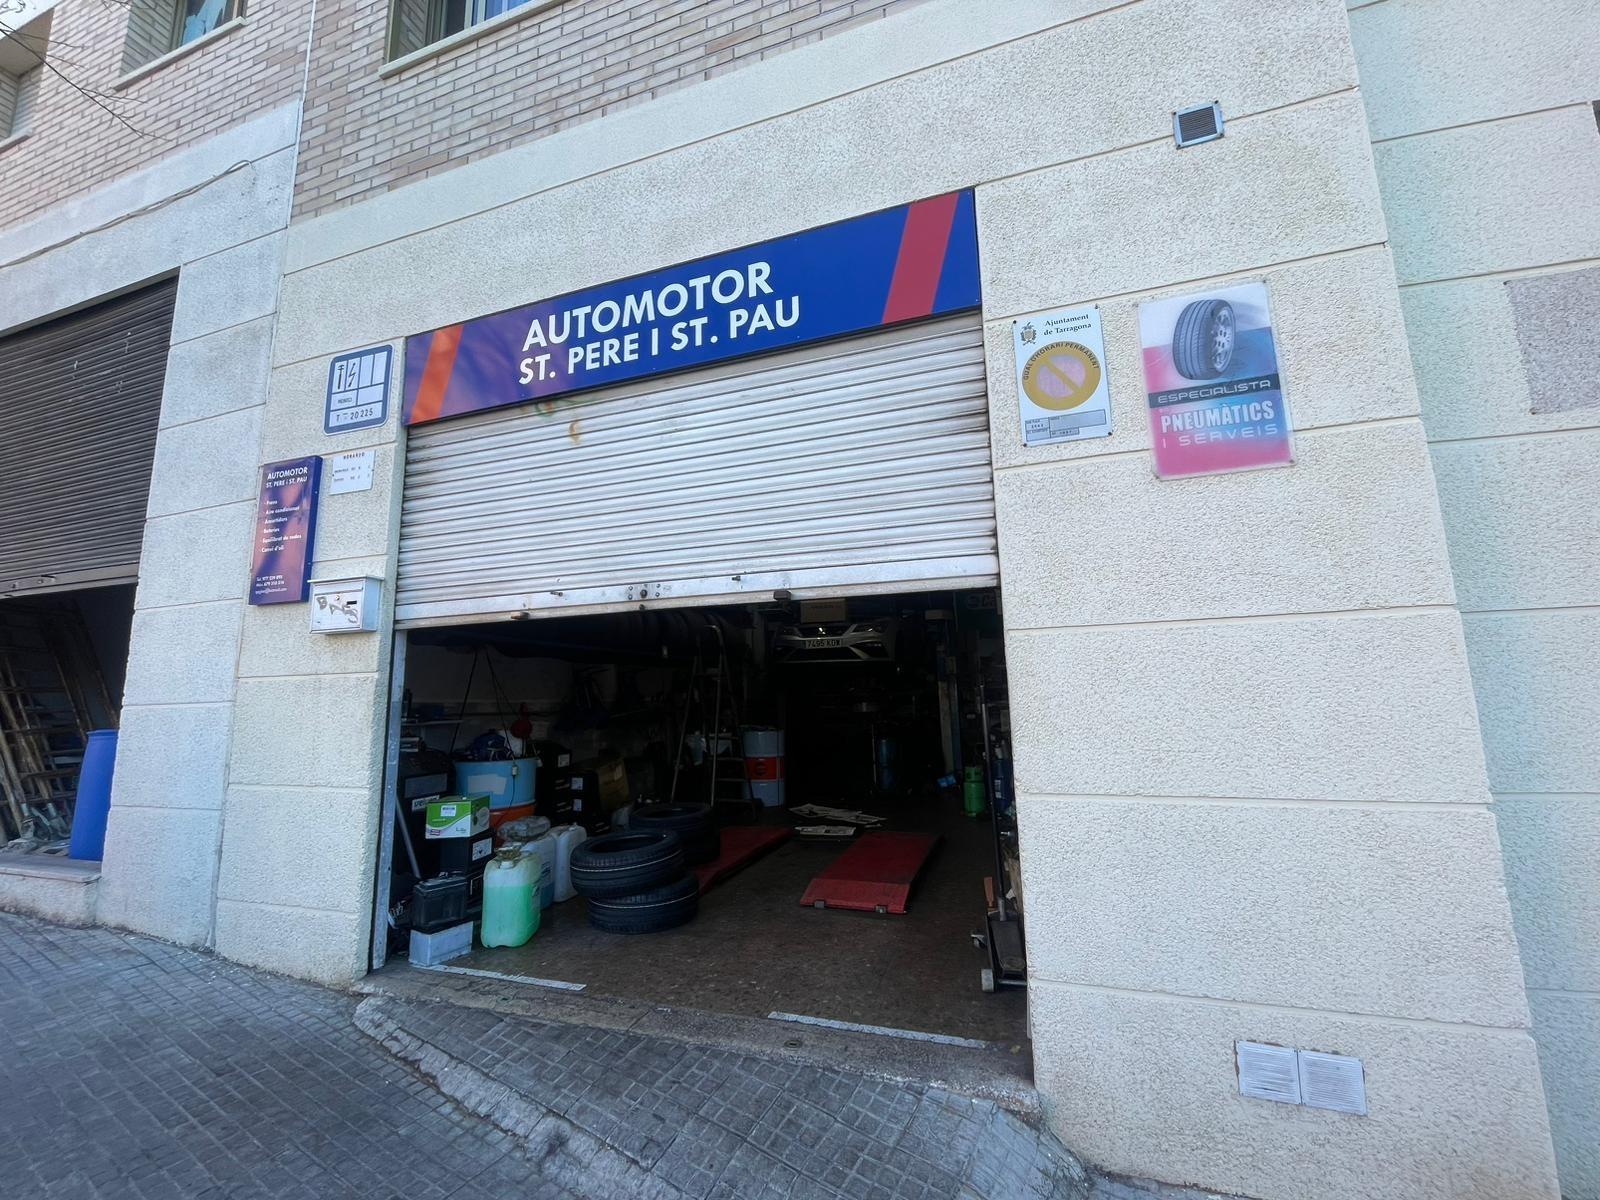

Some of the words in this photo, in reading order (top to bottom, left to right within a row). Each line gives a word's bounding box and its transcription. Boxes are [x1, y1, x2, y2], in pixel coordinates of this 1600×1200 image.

[522, 261, 774, 351] AUTOMOTOR
[1044, 314, 1089, 327] Ajuntament
[1055, 323, 1092, 334] Tarragona
[518, 353, 556, 385] ST.
[567, 332, 639, 374] PERE
[651, 328, 659, 356] I
[671, 317, 718, 351] ST.
[729, 296, 800, 339] PAU
[1023, 361, 1033, 380] GUAL
[1065, 343, 1100, 369] PERMANENT
[1157, 379, 1271, 404] ESPECIALISTA
[1160, 401, 1275, 433] PNEUMÀTICS
[1178, 423, 1279, 447] SERVEIS
[267, 466, 308, 480] AUTOMOTOR
[297, 476, 308, 484] PAU
